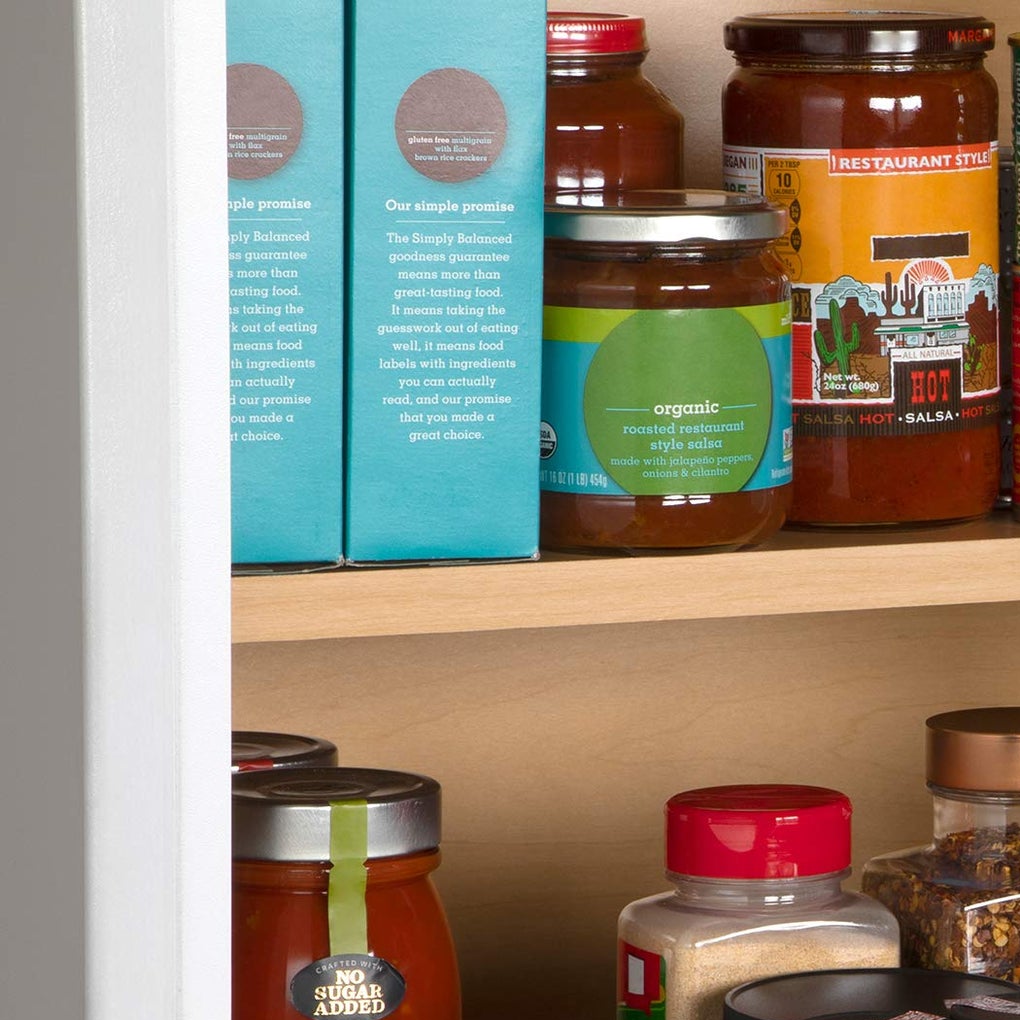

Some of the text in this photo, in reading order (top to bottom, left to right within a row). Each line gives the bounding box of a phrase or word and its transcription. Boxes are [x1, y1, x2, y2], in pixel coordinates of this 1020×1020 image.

[407, 136, 433, 145] gluten
[451, 136, 492, 145] multigrain
[414, 153, 439, 161] brown
[455, 154, 488, 162] crackers
[840, 150, 989, 170] RESTAURANT STYLE
[776, 172, 792, 188] 10
[385, 199, 515, 214] Our simple promise
[386, 232, 513, 246] The Simply Balanced
[388, 251, 510, 264] goodness guarantee
[397, 268, 501, 280] means more than
[393, 286, 503, 300] great-tasting food.
[391, 304, 506, 317] It means taking the
[377, 322, 519, 335] guesswork out of eating
[392, 340, 504, 352] well, it means food
[902, 347, 954, 359] ALL NATURAL
[379, 358, 517, 371] labels with ingredients
[398, 375, 497, 389] you can actually
[823, 372, 861, 381] Net wt.
[823, 382, 880, 393] 24oz (680g)
[911, 368, 950, 404] HOT
[382, 393, 512, 407] read, and our promise
[653, 400, 719, 419] organic
[803, 413, 854, 425] SALSA
[859, 413, 895, 425] HOT
[905, 410, 953, 424] SALSA
[961, 405, 984, 419] HOT
[400, 411, 495, 424] that you made a
[623, 420, 744, 434] roasted restaurant
[409, 429, 485, 443] great choice.
[650, 437, 723, 453] style salsa
[610, 455, 714, 467] made with jalapeño
[642, 467, 730, 478] onions & cilantro
[315, 959, 384, 975] CRAFTED WITH
[335, 969, 365, 985] NO
[314, 983, 384, 1001] SUGAR
[313, 999, 386, 1016] ADDED
